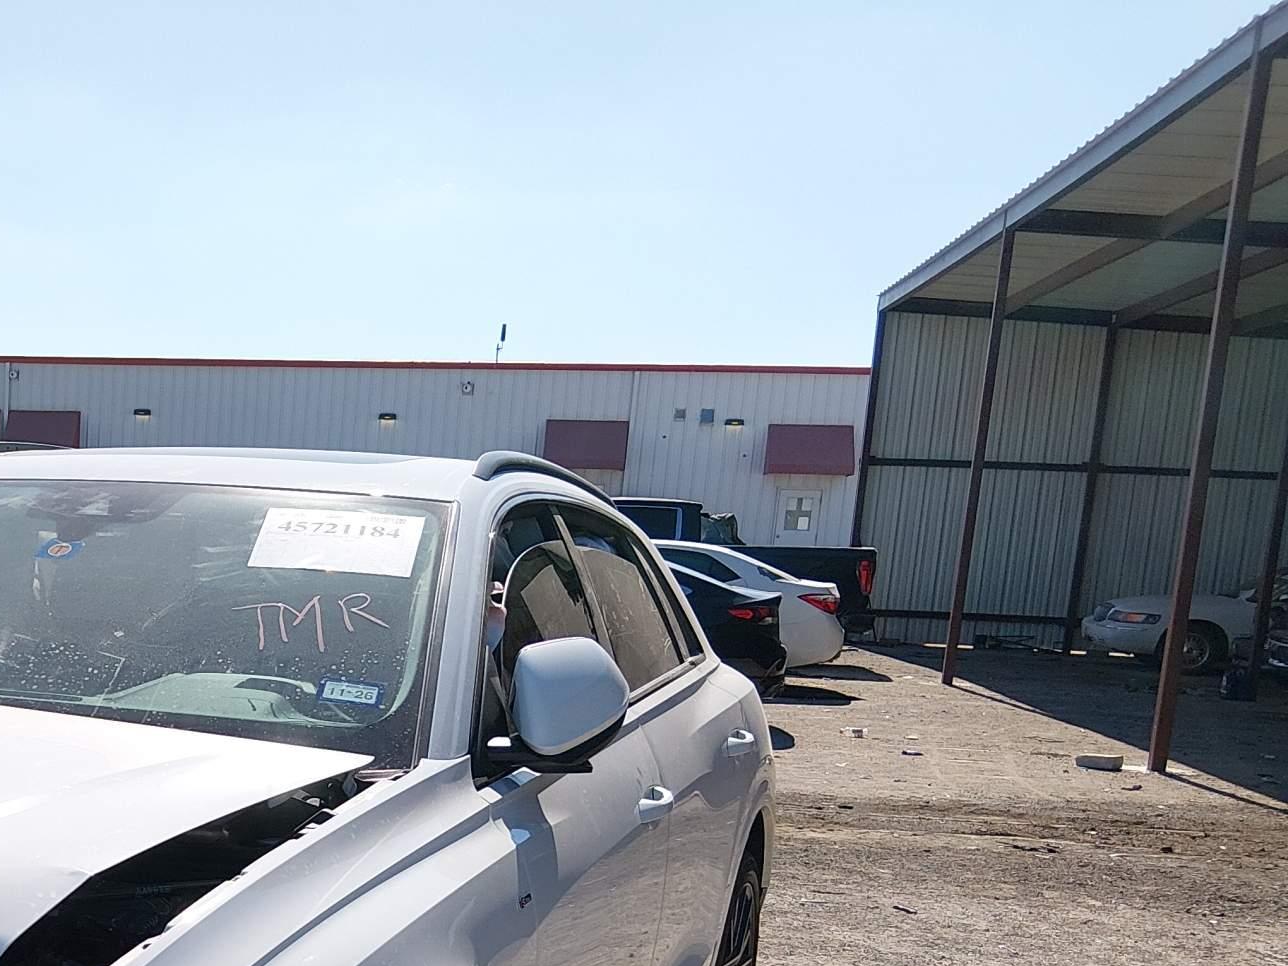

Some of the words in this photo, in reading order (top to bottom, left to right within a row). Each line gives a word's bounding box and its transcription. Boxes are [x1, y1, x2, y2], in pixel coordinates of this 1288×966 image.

[277, 520, 401, 539] 45721184
[232, 593, 391, 653] TMR
[327, 687, 374, 701] 11-26
